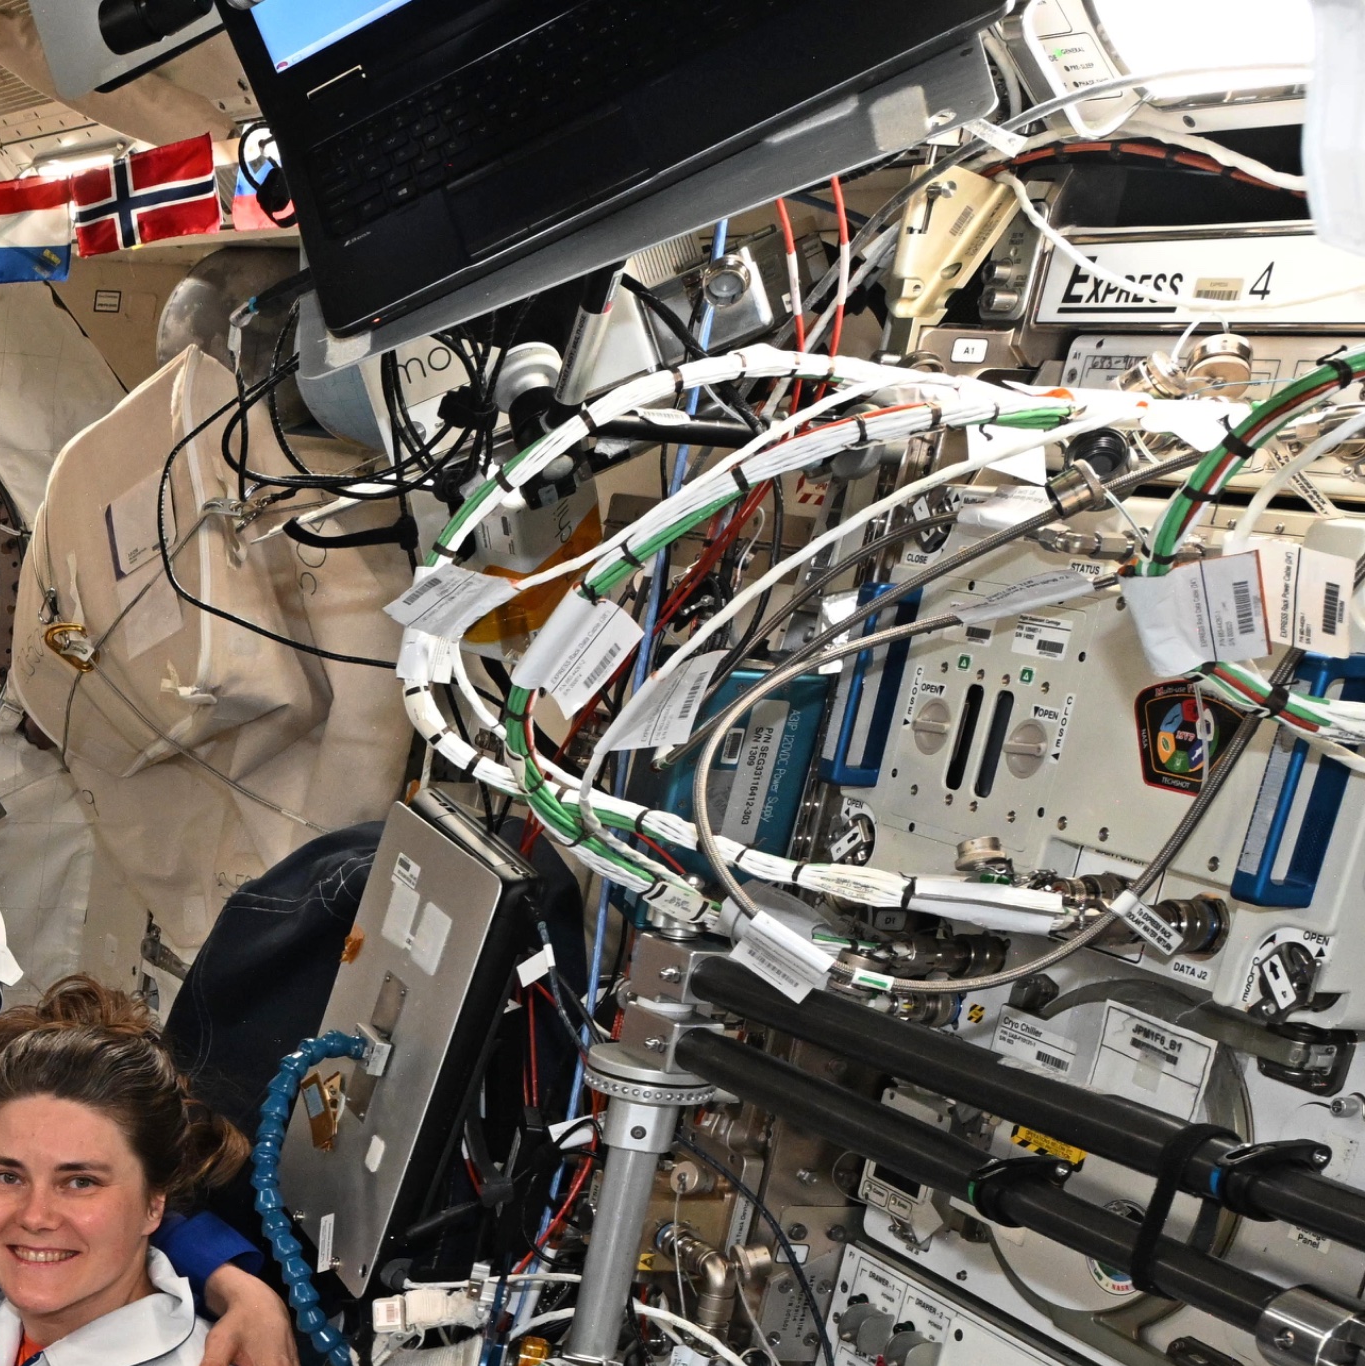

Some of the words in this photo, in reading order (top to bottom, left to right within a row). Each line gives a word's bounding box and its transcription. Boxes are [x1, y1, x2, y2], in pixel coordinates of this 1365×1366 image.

[1061, 256, 1184, 304] EXPRESS
[1248, 260, 1275, 301] 4
[962, 345, 976, 356] A1
[906, 553, 928, 565] CLOSE
[1070, 562, 1101, 575] STATUS
[907, 667, 923, 716] CLOSE
[920, 683, 940, 694] OPEN
[1037, 709, 1059, 721] OPEN
[1056, 695, 1073, 748] CLOSE
[752, 725, 765, 743] S/N
[762, 726, 774, 744] P/N
[746, 746, 759, 768] 1309
[740, 745, 770, 826] SEG33116412-303
[773, 767, 787, 794] Power
[760, 795, 779, 824] Supply
[846, 798, 865, 810] OPEN
[1302, 929, 1331, 947] OPEN
[1173, 961, 1196, 977] DATA
[1196, 968, 1209, 982] J2
[1241, 955, 1260, 1003] CLOSE
[1003, 1015, 1020, 1031] Cryo
[1020, 1022, 1044, 1039] Chiller
[1130, 1023, 1183, 1053] JPM1F6_B1
[1296, 1232, 1321, 1250] Panel
[868, 1270, 896, 1291] DRAWER-1
[914, 1296, 944, 1320] DRAWER-2
